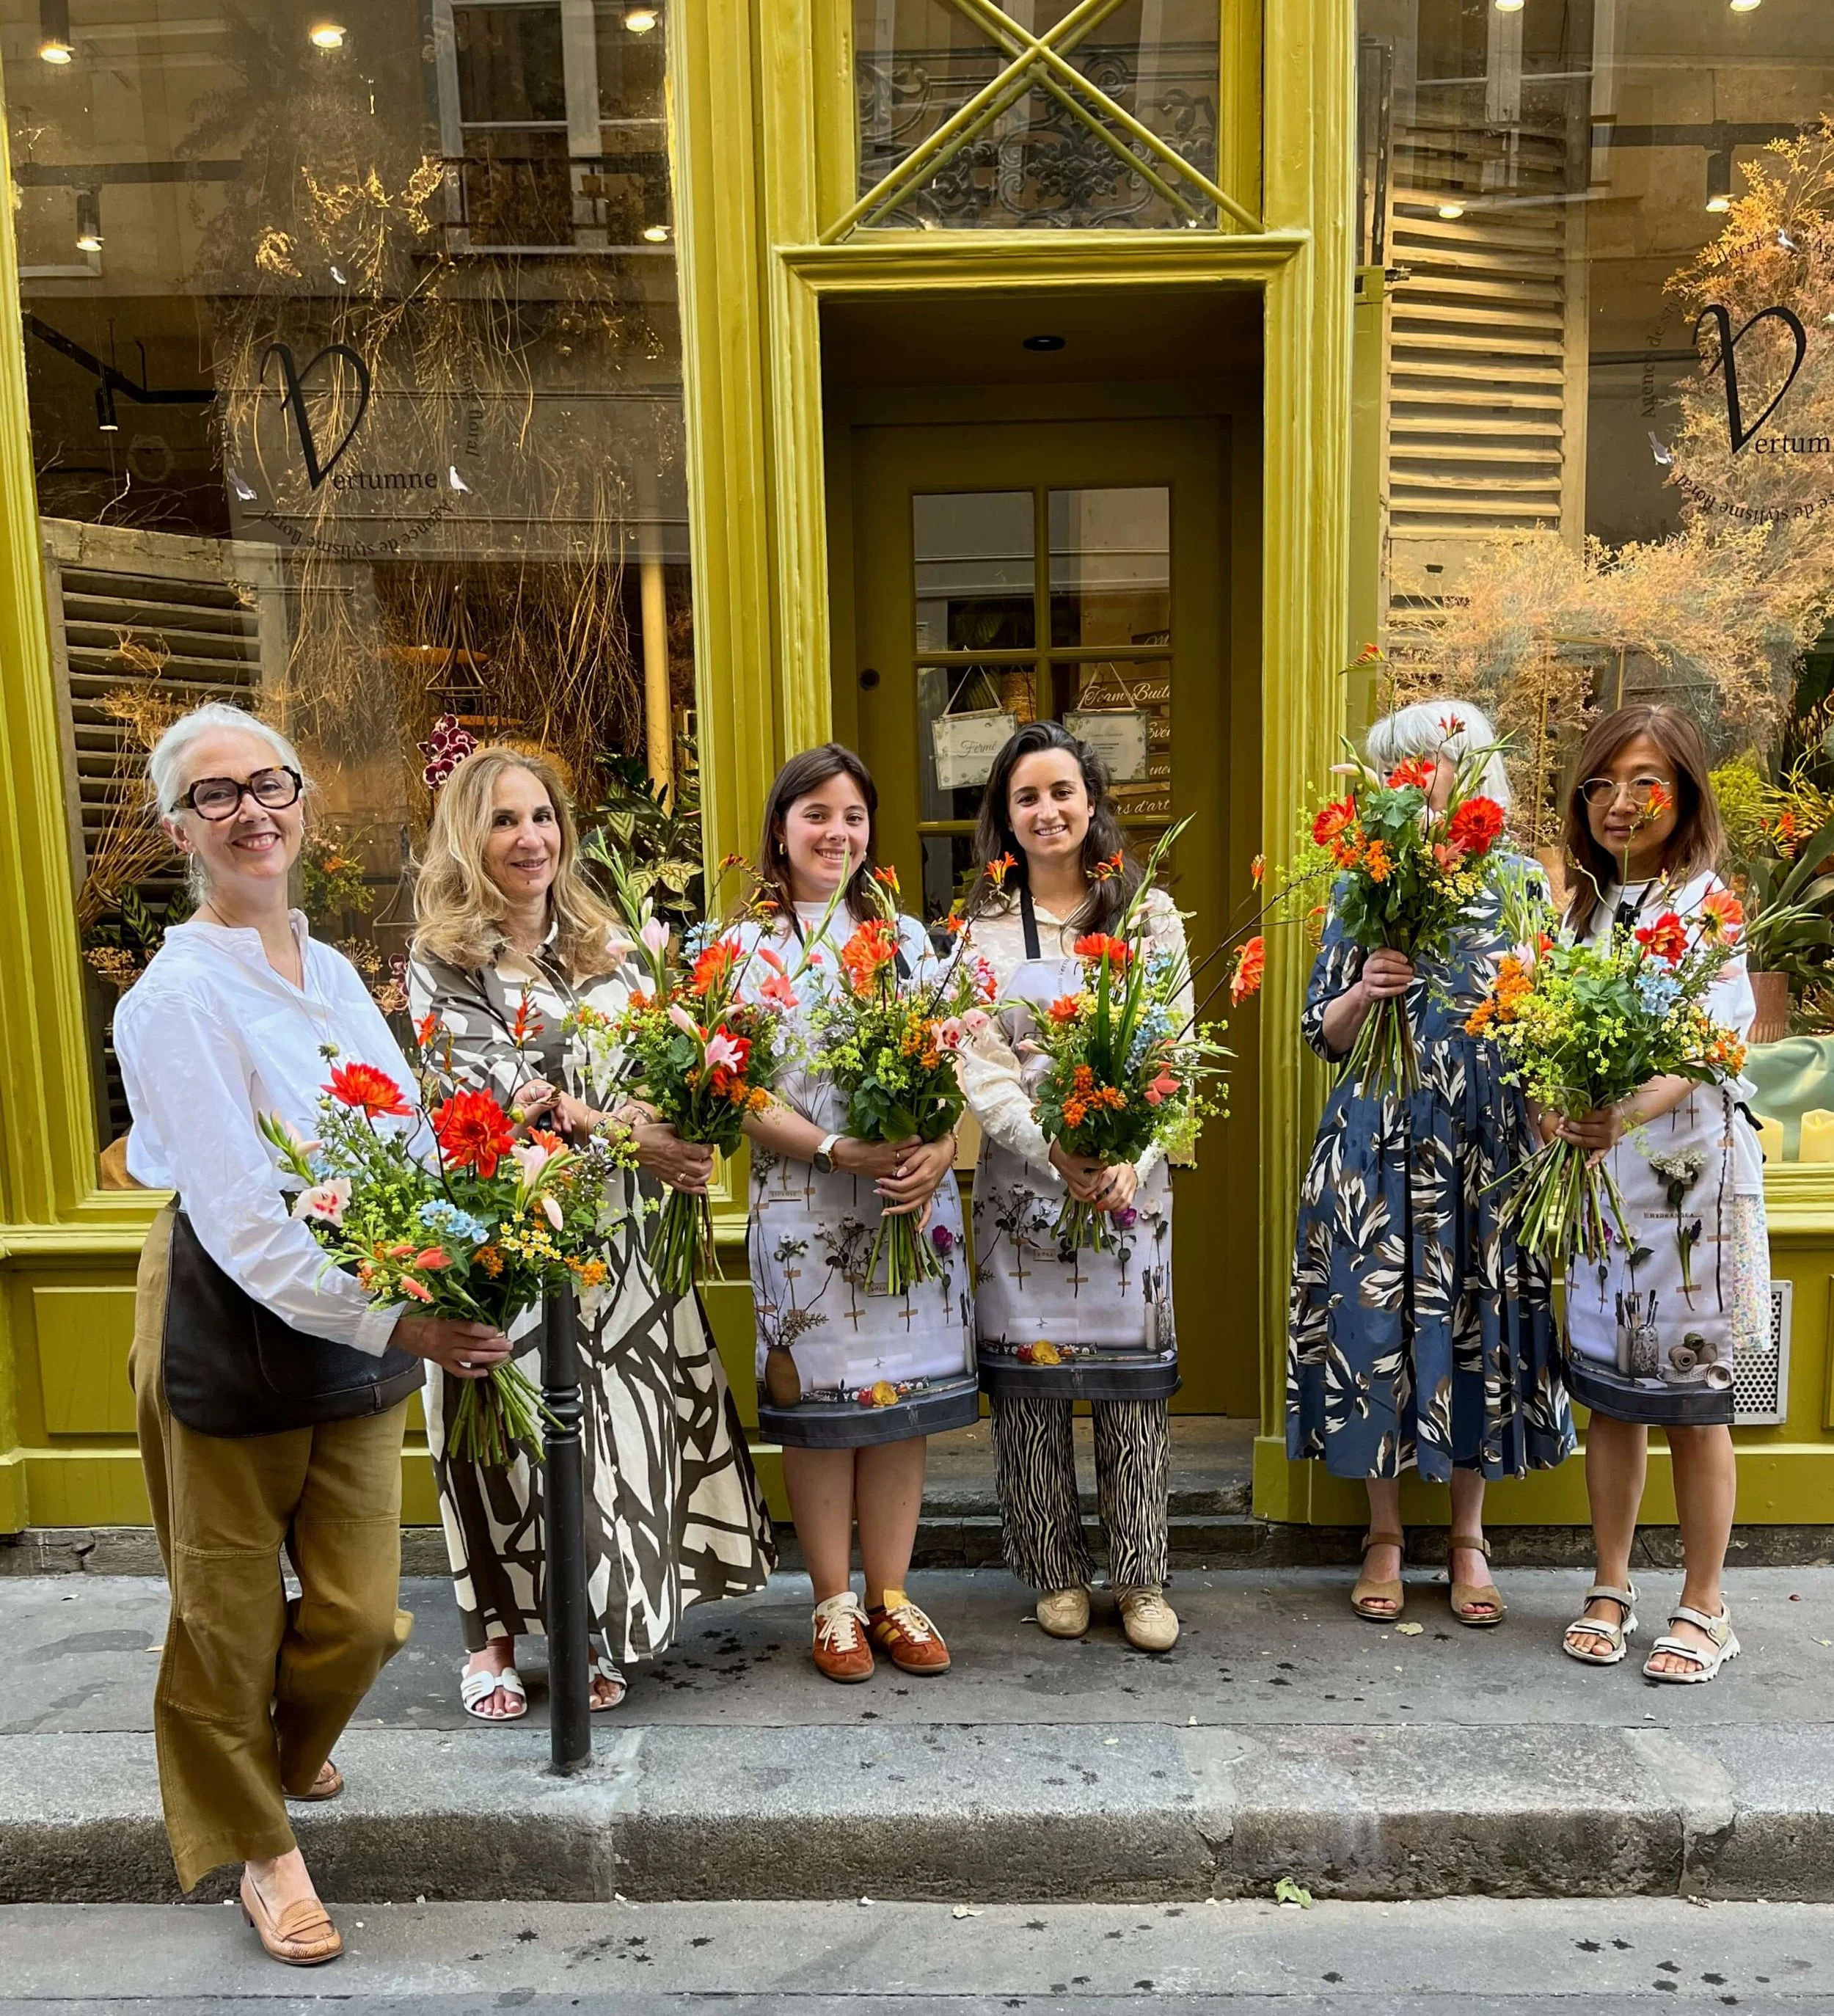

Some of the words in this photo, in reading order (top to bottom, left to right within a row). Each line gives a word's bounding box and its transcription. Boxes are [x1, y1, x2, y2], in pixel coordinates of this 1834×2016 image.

[1646, 324, 1665, 348] de
[1692, 304, 1834, 454] Vertum
[1675, 474, 1717, 512] floral
[1794, 503, 1814, 519] de
[307, 536, 375, 560] stylisme
[379, 538, 398, 555] de
[1136, 799, 1170, 814] d'art
